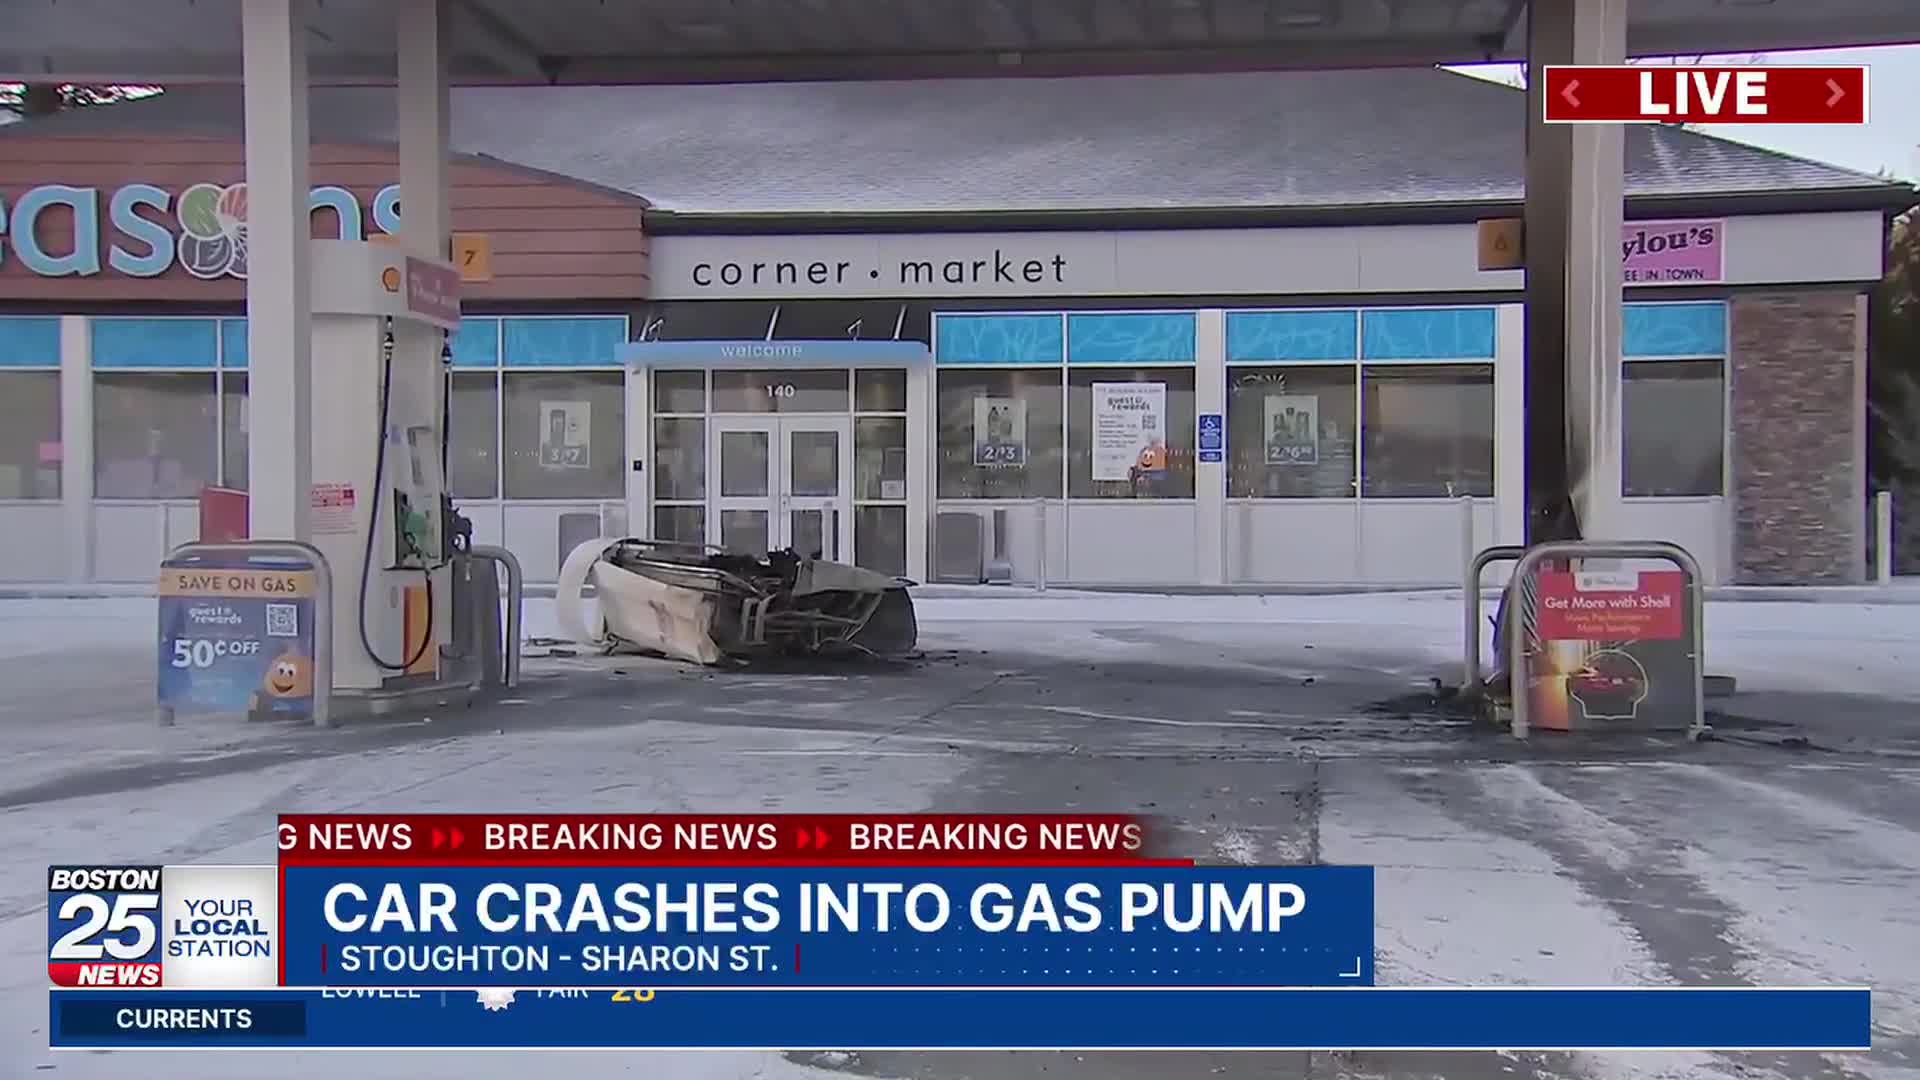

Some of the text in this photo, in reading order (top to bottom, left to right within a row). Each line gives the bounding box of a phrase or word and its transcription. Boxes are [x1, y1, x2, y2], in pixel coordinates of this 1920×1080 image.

[1622, 228, 1713, 262] ylou's
[464, 250, 476, 266] 7
[692, 250, 1067, 286] corner market
[1624, 268, 1704, 281] EE IN TOWN
[720, 343, 802, 358] welcome
[765, 384, 795, 398] 140
[179, 575, 297, 592] SAVE ON GAS
[1544, 595, 1672, 609] Get More with Shell
[230, 641, 261, 655] OFF
